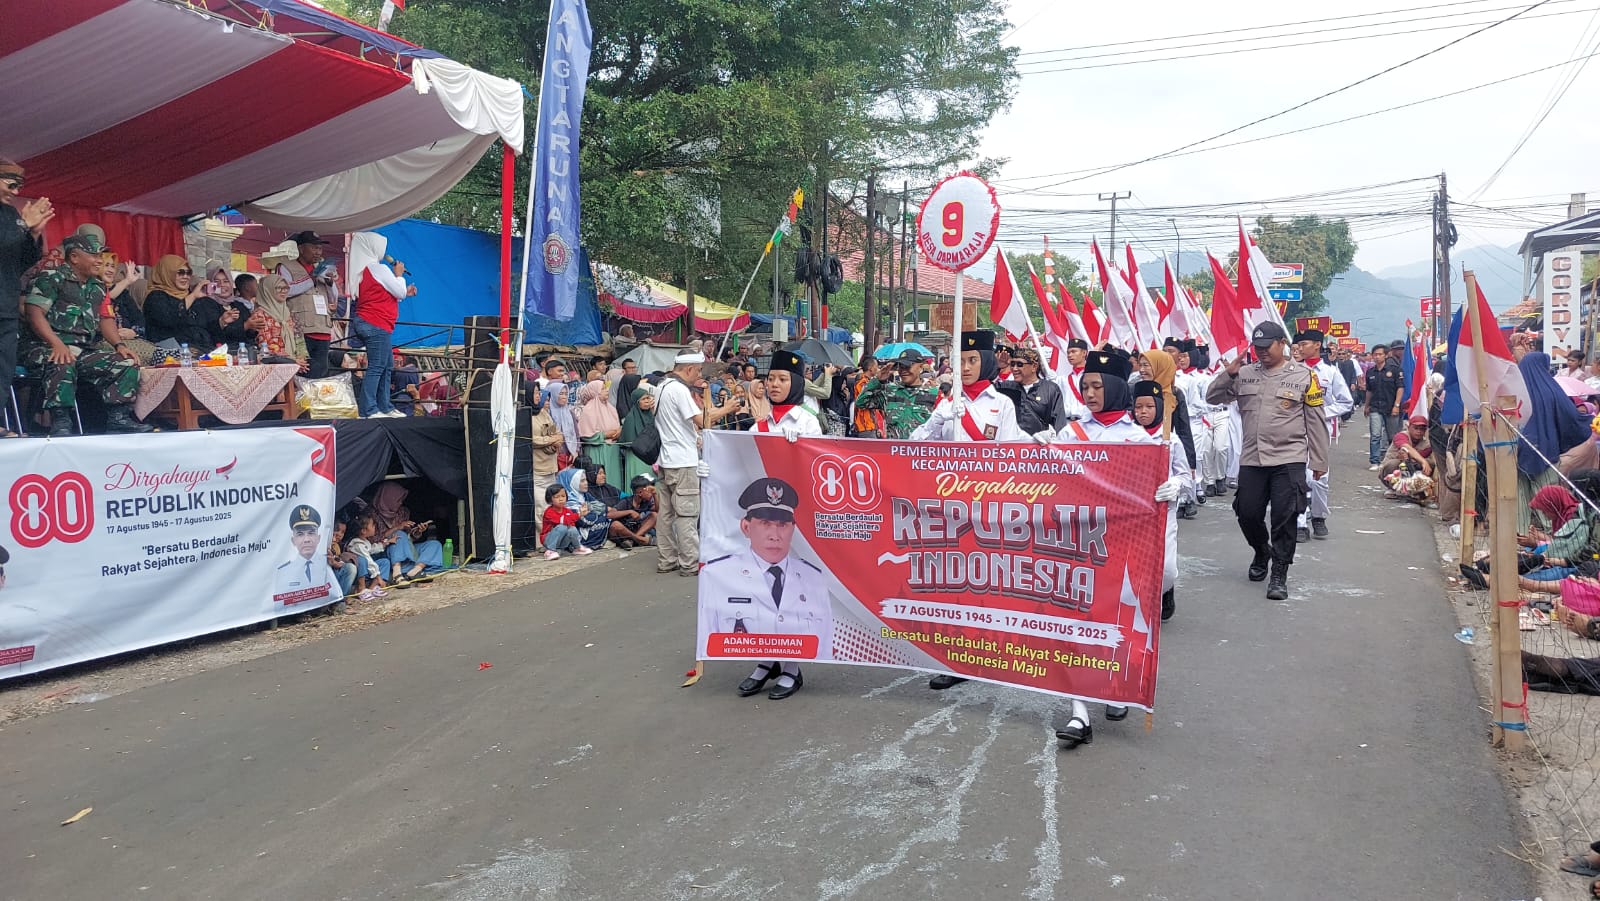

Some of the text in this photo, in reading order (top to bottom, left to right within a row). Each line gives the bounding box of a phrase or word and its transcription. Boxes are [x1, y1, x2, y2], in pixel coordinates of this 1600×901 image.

[942, 201, 964, 248] 9
[922, 231, 986, 263] DESA DARMARAJA
[1551, 256, 1572, 361] GORDYN
[891, 445, 1109, 462] PEMERINTAH DESA DARMARAJA
[911, 459, 1085, 475] KECAMATAN DARMARAJA
[104, 461, 210, 496] Dirgahayu
[810, 453, 883, 511] 80
[935, 472, 1059, 503] Dirgahayu
[9, 471, 95, 548] 80
[106, 482, 299, 519] REPUBLIK INDONESIA
[815, 512, 883, 522] Bersatu Berdaulat
[107, 526, 115, 534] 17
[116, 522, 150, 535] Agustus
[151, 519, 168, 530] 1945
[175, 518, 183, 526] 17
[183, 514, 214, 526] Agustus
[214, 511, 232, 522] 2025
[815, 522, 880, 532] Rakyat Sejahtera
[815, 530, 872, 541] Indonesia Maju
[891, 497, 1108, 562] REPUBLIK
[101, 540, 271, 577] Rakyat Sejahtera, Indonesia Maju"
[142, 533, 239, 556] "Bersatu Berdaulat
[907, 551, 1095, 610] INDONESIA
[894, 604, 906, 614] 17
[909, 606, 962, 620] AGUSTUS
[965, 611, 992, 624] 1945
[1005, 616, 1018, 627] 17
[1021, 619, 1074, 635] AGUSTUS
[1077, 626, 1107, 640] 2025
[723, 637, 803, 647] ADANG BUDIMAN
[881, 627, 1121, 673] Bersatu Berdaulat, Rakyat Sejahtera
[947, 650, 1047, 677] Indonesia Maju
